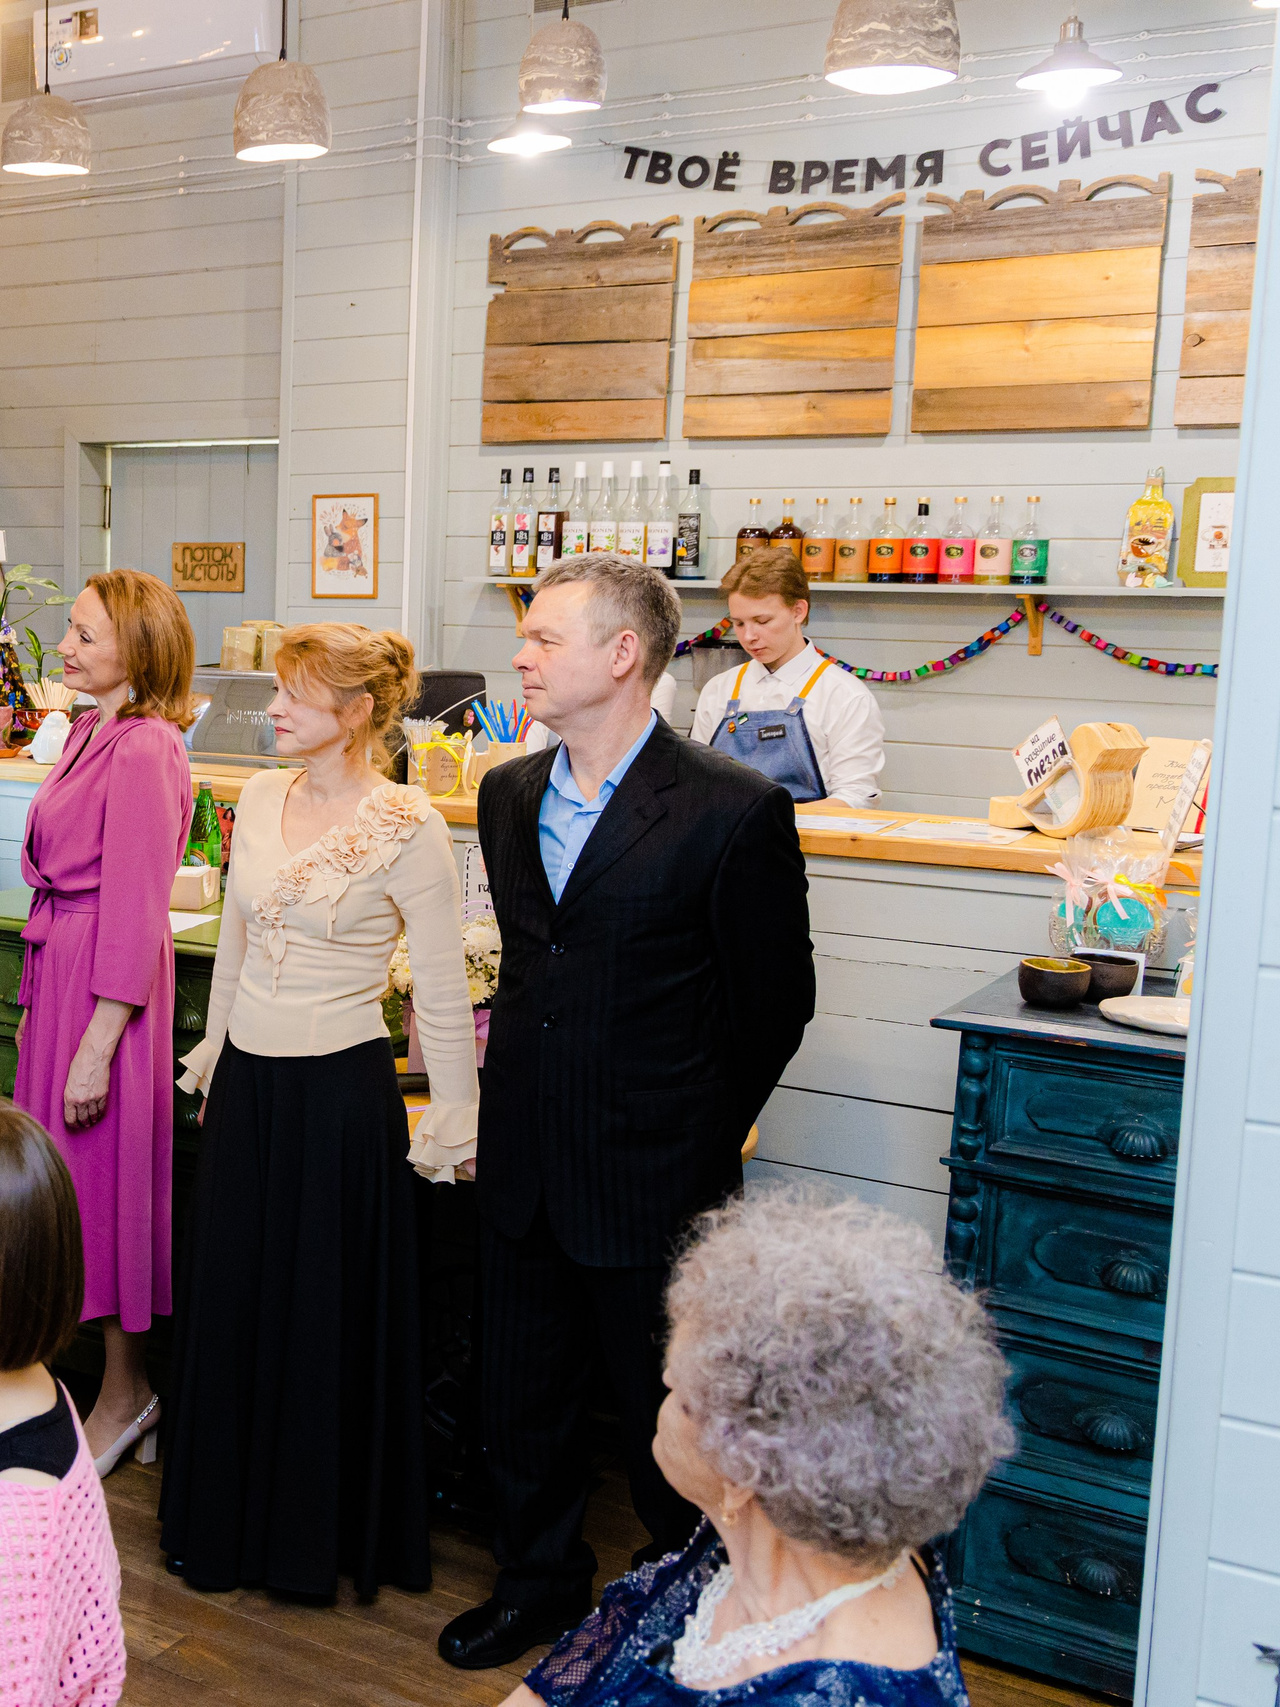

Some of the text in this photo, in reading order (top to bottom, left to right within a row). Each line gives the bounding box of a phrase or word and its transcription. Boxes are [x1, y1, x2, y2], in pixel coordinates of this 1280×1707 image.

[623, 83, 1222, 194] ТВОЁ ВРЕМЯ СЕЙЧАС
[183, 546, 234, 562] ПОТОК
[174, 562, 237, 581] ЧИСТОТЫ
[1030, 734, 1040, 746] на
